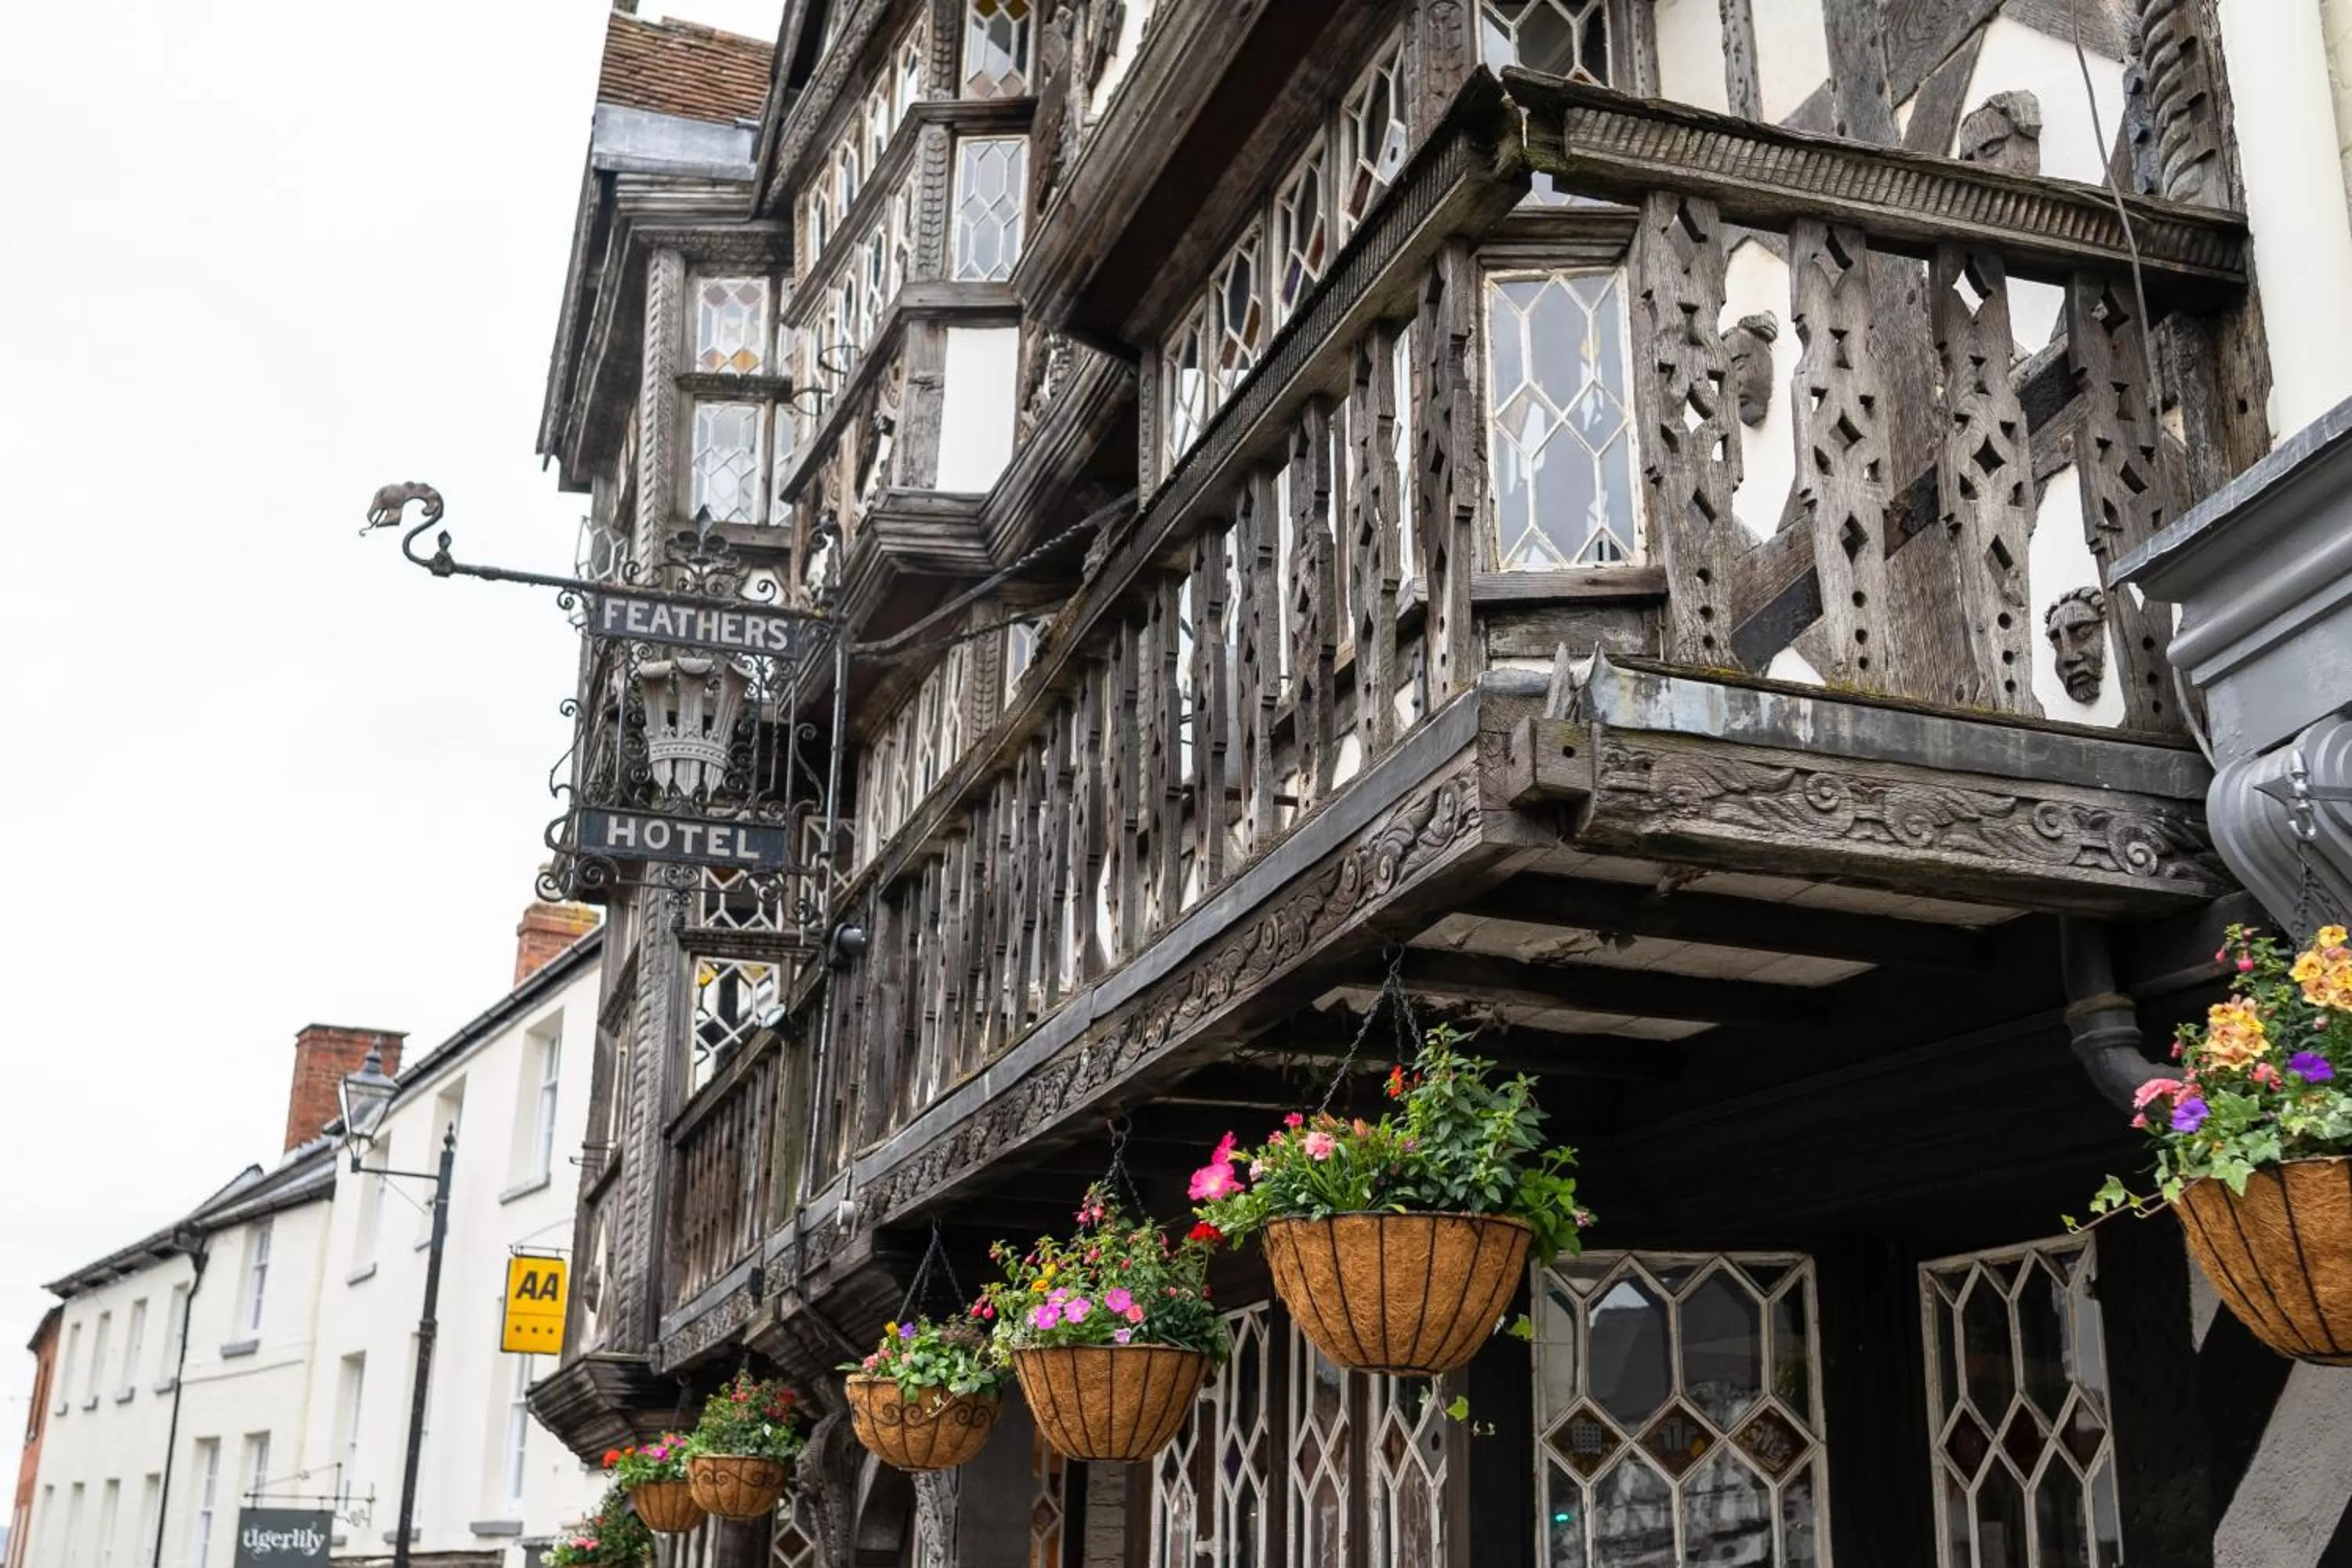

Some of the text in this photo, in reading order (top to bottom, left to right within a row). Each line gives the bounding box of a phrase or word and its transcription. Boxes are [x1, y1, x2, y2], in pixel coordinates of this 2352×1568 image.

[602, 598, 789, 651] FEATHERS
[607, 815, 760, 860] HOTEL
[515, 1270, 559, 1301] AA
[242, 1520, 326, 1559] tigerlily
